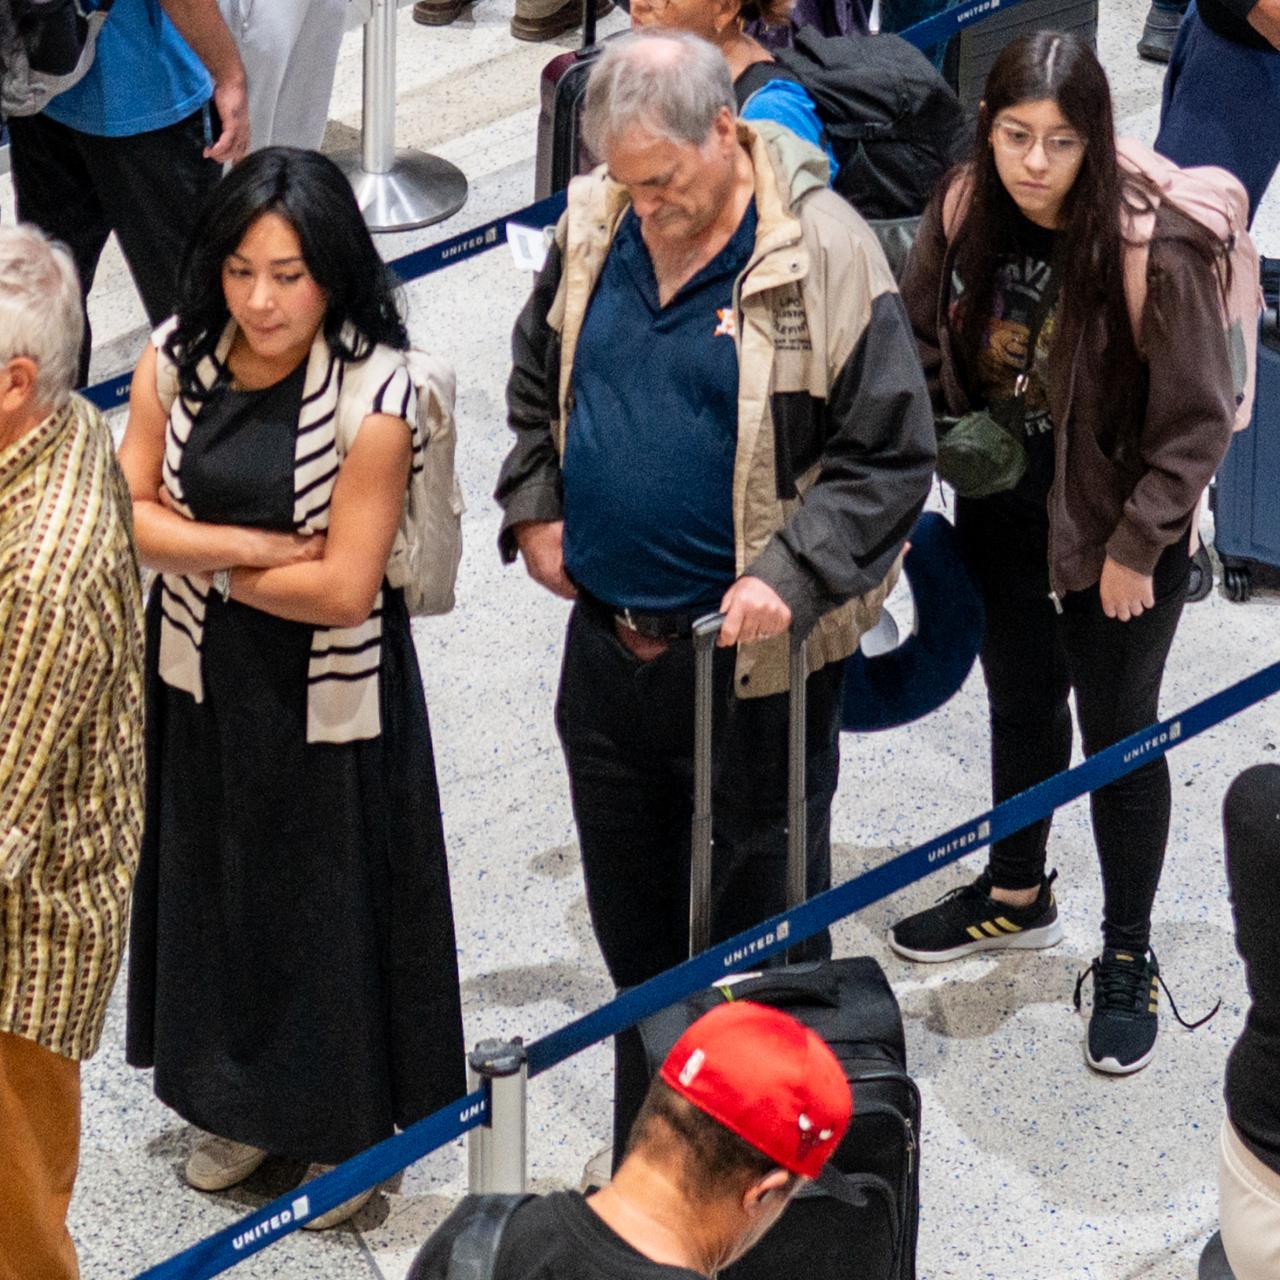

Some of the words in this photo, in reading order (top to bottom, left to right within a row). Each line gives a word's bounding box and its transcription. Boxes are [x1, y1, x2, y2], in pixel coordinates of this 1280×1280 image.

[957, 2, 991, 22] UNITED
[442, 235, 483, 260] UNITED
[1124, 730, 1167, 763] UNITED
[928, 830, 975, 863] UNITED
[723, 933, 774, 967] UNITED
[233, 1209, 292, 1250] UNITED
